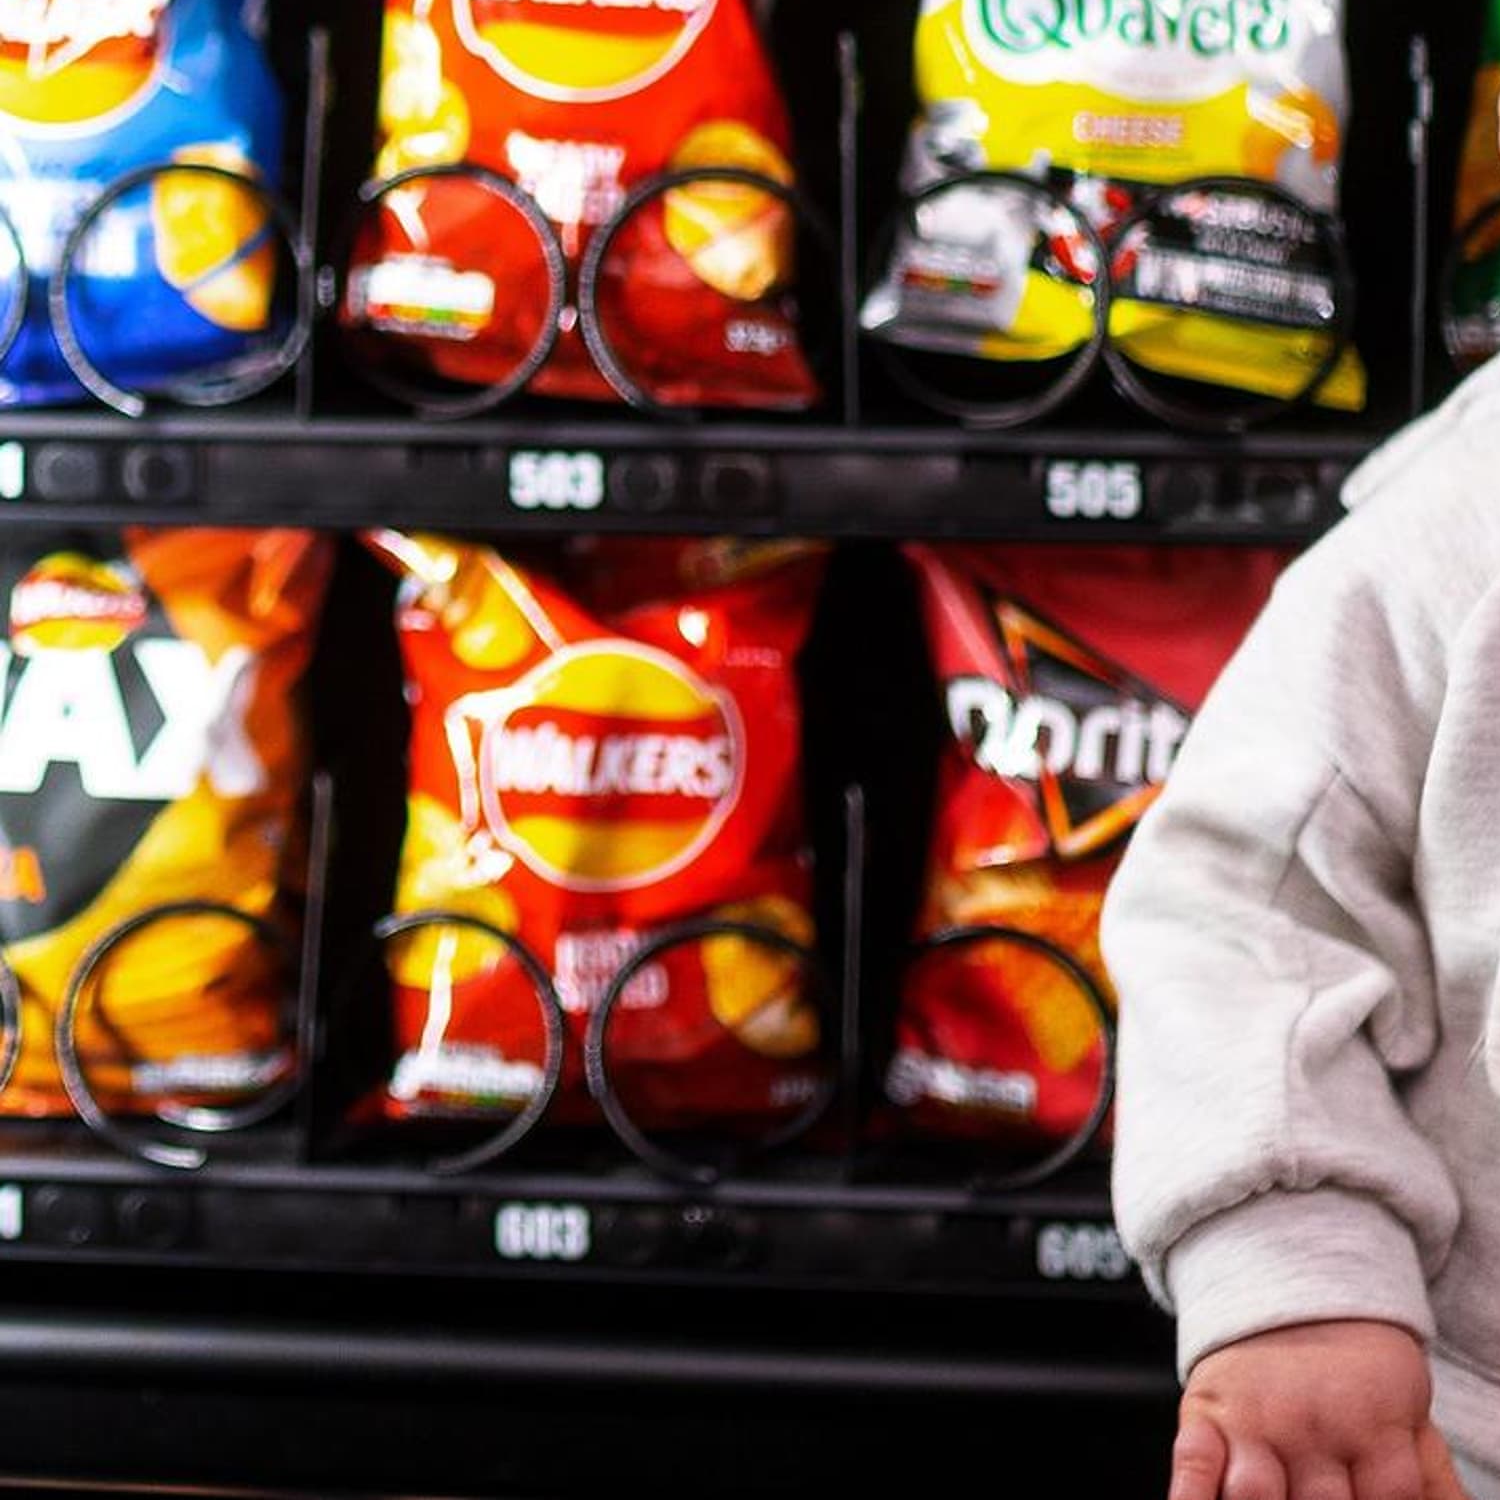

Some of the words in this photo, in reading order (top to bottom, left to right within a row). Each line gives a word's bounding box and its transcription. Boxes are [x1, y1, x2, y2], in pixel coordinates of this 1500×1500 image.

[1046, 461, 1143, 520] 505
[0, 636, 264, 801] AX
[492, 721, 733, 800] WALKERS
[946, 677, 1196, 785] Dorit
